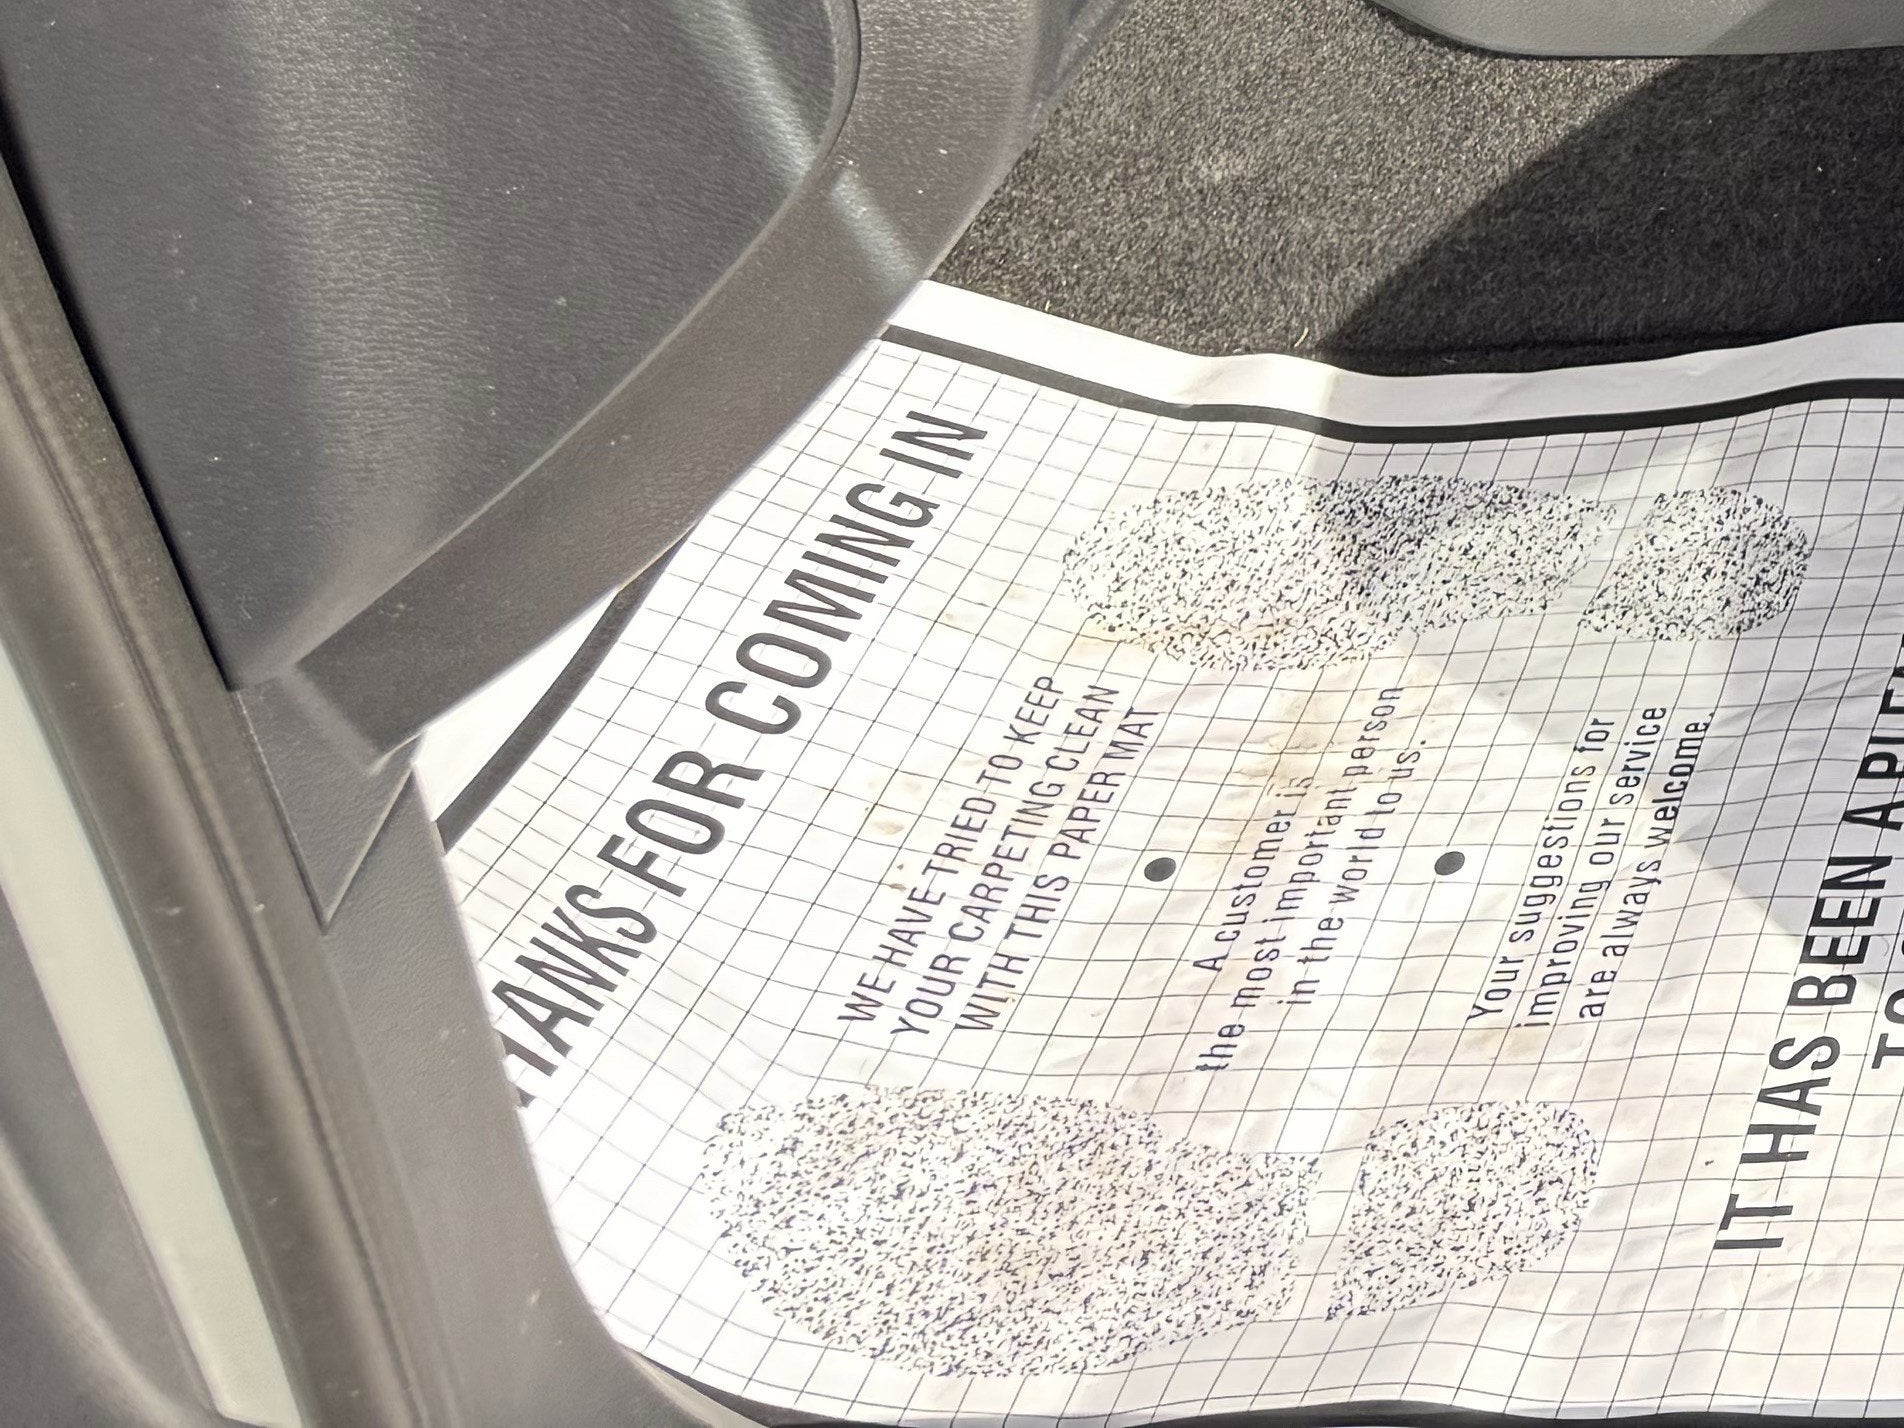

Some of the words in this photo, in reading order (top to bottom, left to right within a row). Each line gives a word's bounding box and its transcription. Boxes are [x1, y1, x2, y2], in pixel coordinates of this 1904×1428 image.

[596, 749, 765, 897] FOR
[704, 482, 942, 735] COMING
[878, 411, 988, 479] IN
[837, 972, 897, 1021] WE
[872, 887, 947, 968] HAVE
[922, 797, 998, 875] TRIED
[976, 754, 1024, 784] TO
[1003, 676, 1064, 745] KEEP
[1365, 790, 1403, 816] to
[1391, 740, 1427, 780] us.
[890, 954, 971, 1034] YOUR
[949, 780, 1065, 942] CARPETING
[1045, 684, 1120, 772] CLEAN
[954, 952, 1030, 1031] WITH
[1005, 874, 1070, 939] THIS
[1047, 771, 1126, 860] PAPER
[1103, 707, 1159, 760] MAT
[1192, 948, 1228, 972] A
[1215, 807, 1297, 942] customer
[1276, 775, 1314, 798] is
[1195, 1023, 1246, 1072] the
[1231, 934, 1287, 1008] most
[1263, 786, 1358, 923] important
[1343, 687, 1404, 777] person
[1297, 917, 1345, 964] the
[1330, 827, 1386, 904] world
[1466, 955, 1525, 1021] Your
[1509, 765, 1597, 943] suggestions
[1573, 717, 1615, 753] for
[1514, 879, 1613, 1028] improving
[1589, 817, 1626, 865] our
[1609, 707, 1667, 806] service
[1579, 969, 1617, 1019] are
[1600, 858, 1663, 957] always
[1645, 712, 1716, 849] welcome.
[1787, 855, 1894, 1007] BEEN
[1277, 978, 1320, 1005] in
[1739, 1036, 1841, 1164] HAS
[1713, 1193, 1794, 1250] IT
